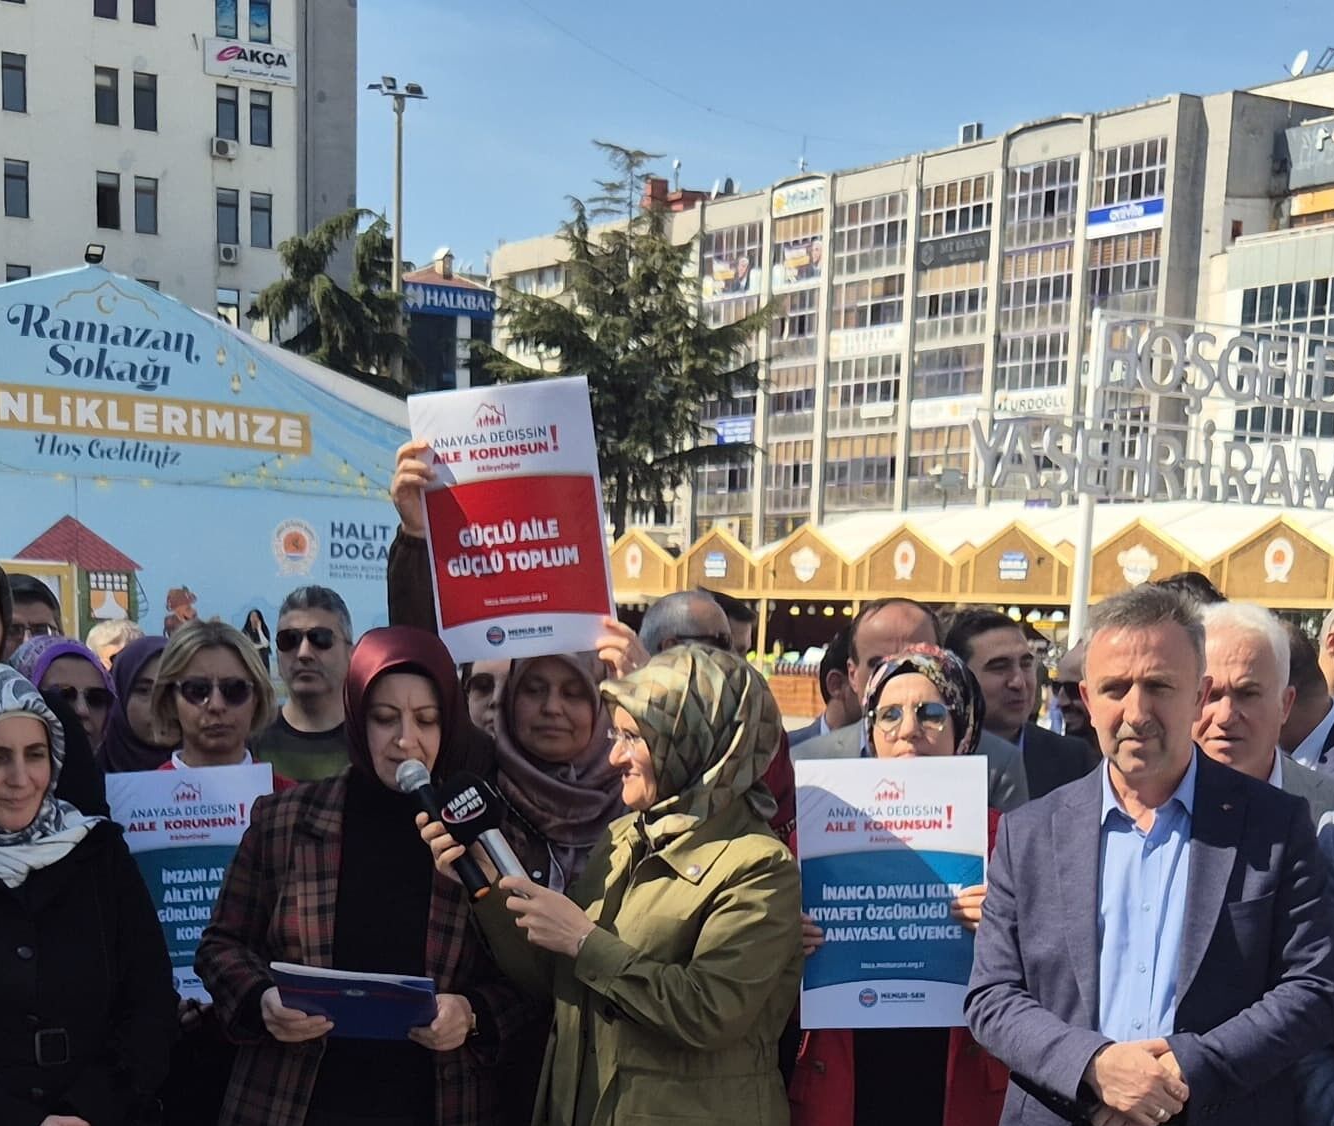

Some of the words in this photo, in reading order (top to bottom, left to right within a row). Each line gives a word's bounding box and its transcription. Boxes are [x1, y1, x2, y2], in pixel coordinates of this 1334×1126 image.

[237, 48, 287, 68] AKÇA
[7, 303, 200, 364] Ramazan
[45, 343, 170, 392] Sokağı
[433, 433, 488, 449] ANAYASA
[432, 451, 463, 465] AİLE
[458, 519, 516, 549] GÜÇLÜ
[519, 516, 560, 543] AİLE
[330, 541, 390, 561] DOĞA
[447, 550, 504, 579] GÜÇLÜ
[506, 544, 580, 572] TOPLUM
[447, 785, 479, 813] HABER
[130, 807, 182, 819] ANAYASA
[827, 806, 883, 818] ANAYASA
[128, 821, 157, 833] AİLE
[825, 821, 856, 833] AİLE
[161, 867, 207, 885] İMZANI
[208, 867, 225, 882] AT
[162, 886, 204, 903] AİLEYİ
[822, 883, 875, 901] İNANCA
[876, 883, 924, 900] DAYALI
[808, 907, 864, 921] KIYAFET
[866, 902, 948, 921] ÖZGÜRLÜĞÜ
[176, 925, 205, 941] KOR
[825, 925, 896, 942] ANAYASAL
[897, 923, 962, 940] GÜVENCE
